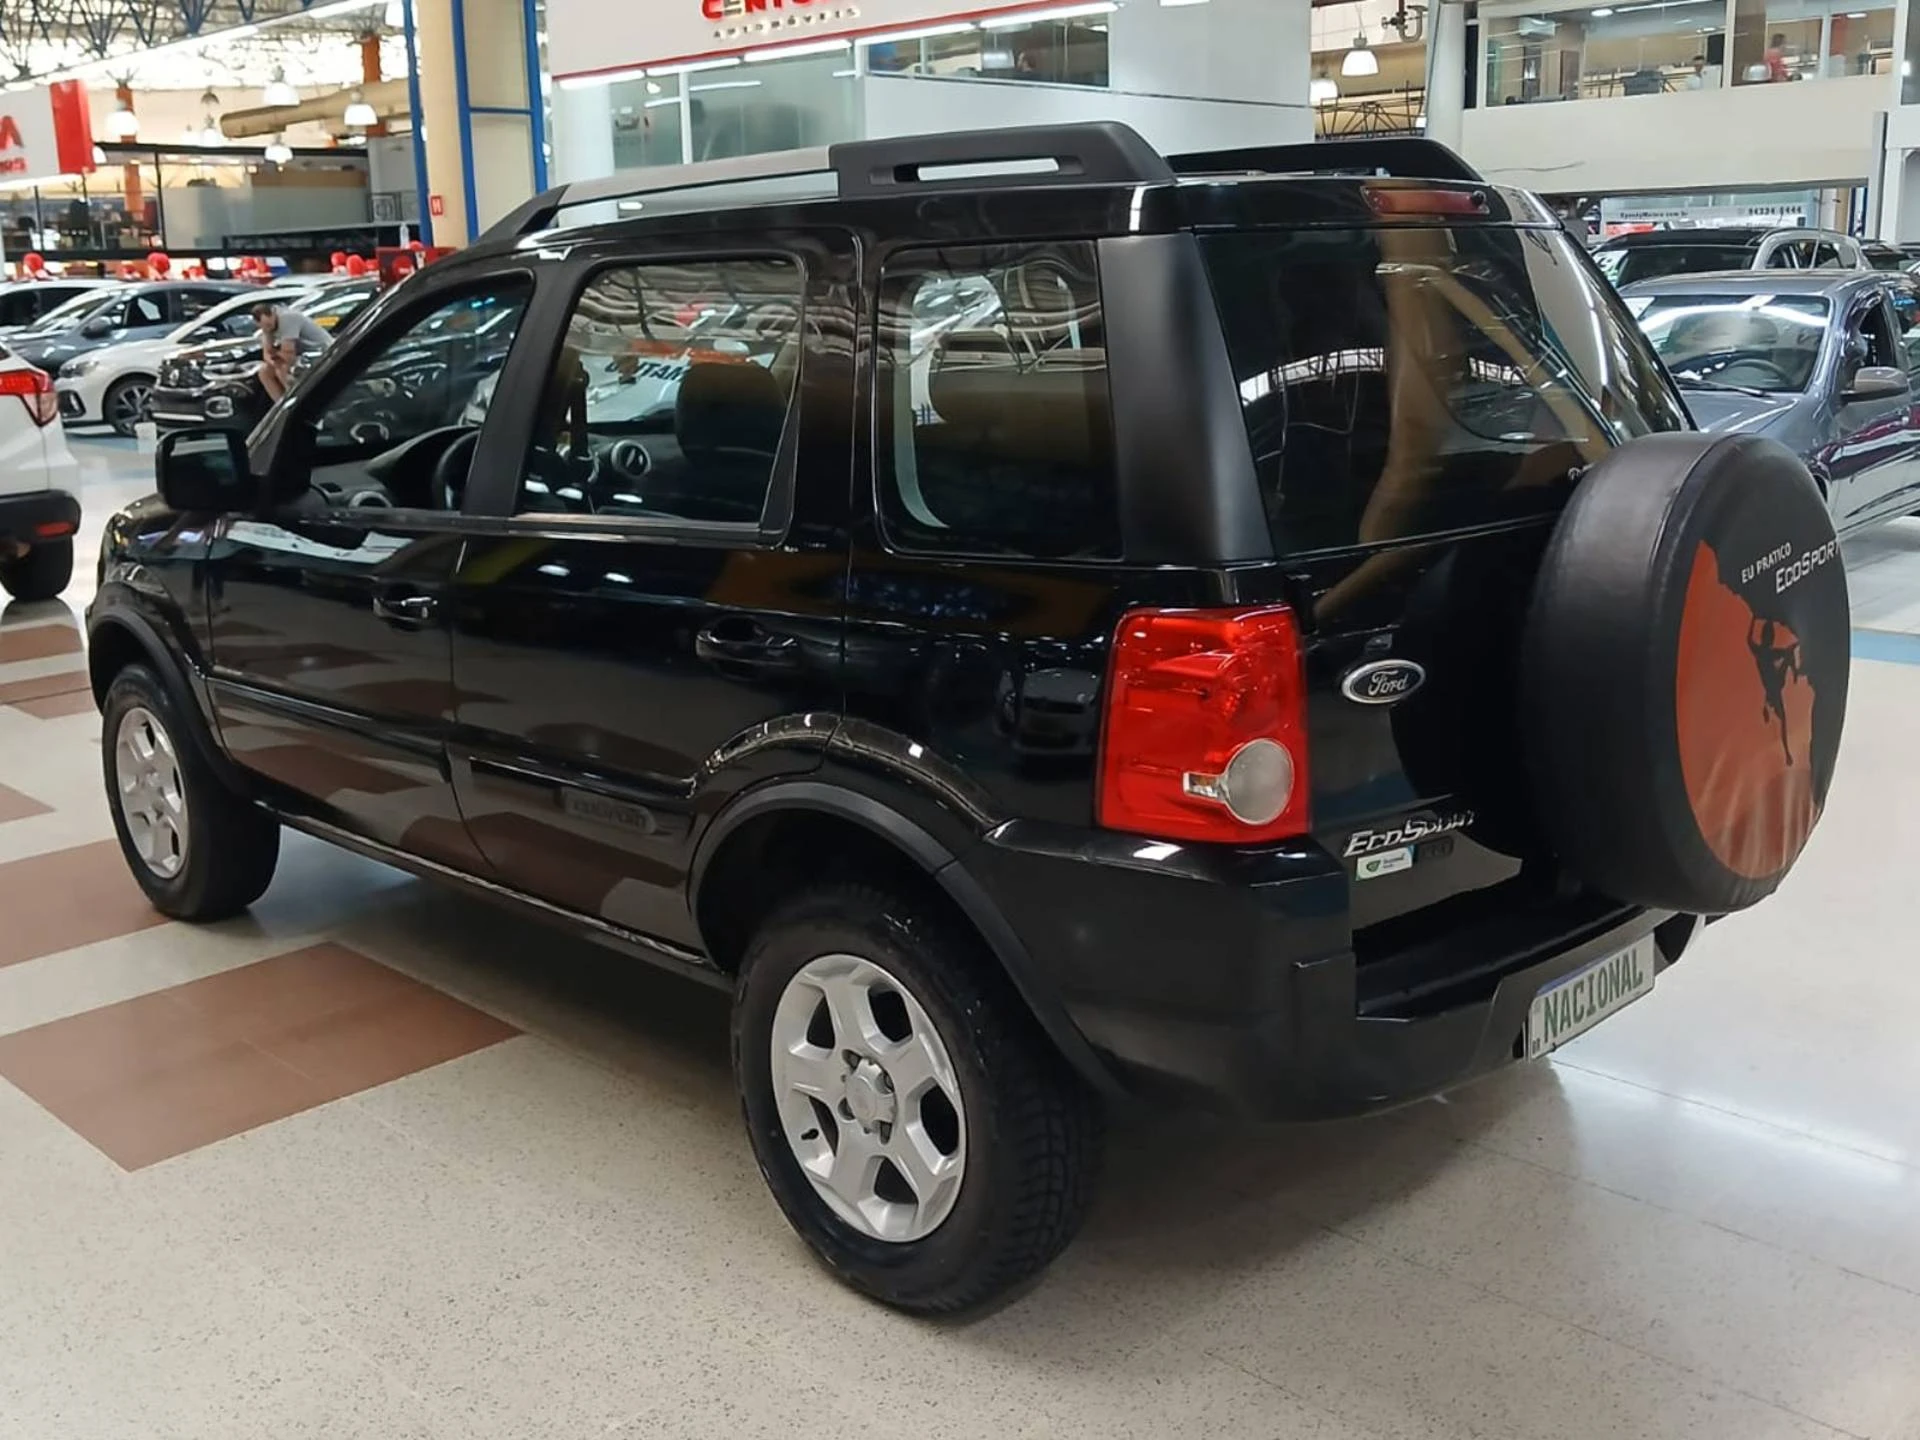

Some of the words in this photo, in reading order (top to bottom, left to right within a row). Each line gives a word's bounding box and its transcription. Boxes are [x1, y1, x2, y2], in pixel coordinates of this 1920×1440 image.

[1741, 565, 1755, 584] EU
[1756, 541, 1792, 575] PRATICO
[1367, 669, 1409, 696] Ford
[1543, 947, 1644, 1044] NACIONAL
